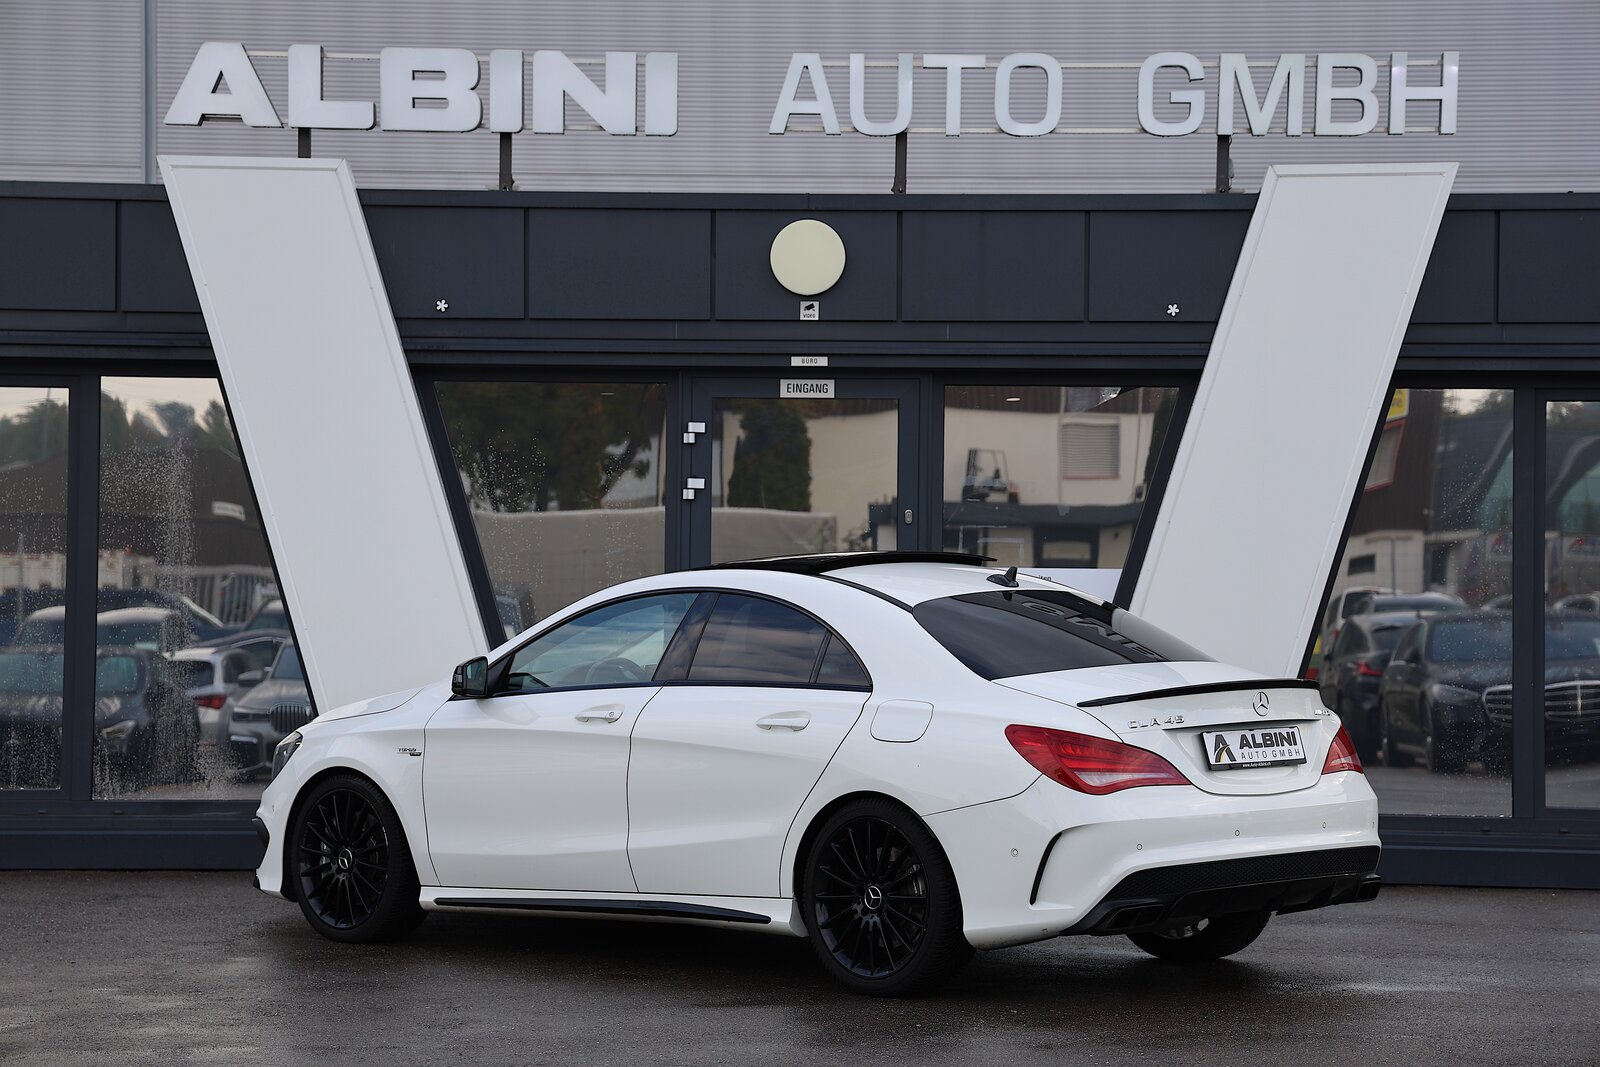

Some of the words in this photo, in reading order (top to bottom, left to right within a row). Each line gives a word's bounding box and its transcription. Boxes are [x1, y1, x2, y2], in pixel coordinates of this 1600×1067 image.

[164, 42, 679, 136] ALBINI
[769, 52, 1063, 137] AUTO
[1137, 51, 1460, 137] GMBH
[801, 357, 818, 365] BÜRO
[786, 383, 829, 394] EINGANG
[1128, 718, 1161, 729] CLA
[1164, 715, 1185, 725] 45
[1239, 731, 1298, 750] ALBINI
[1241, 750, 1268, 760] AUTO
[1271, 748, 1301, 758] GMBH
